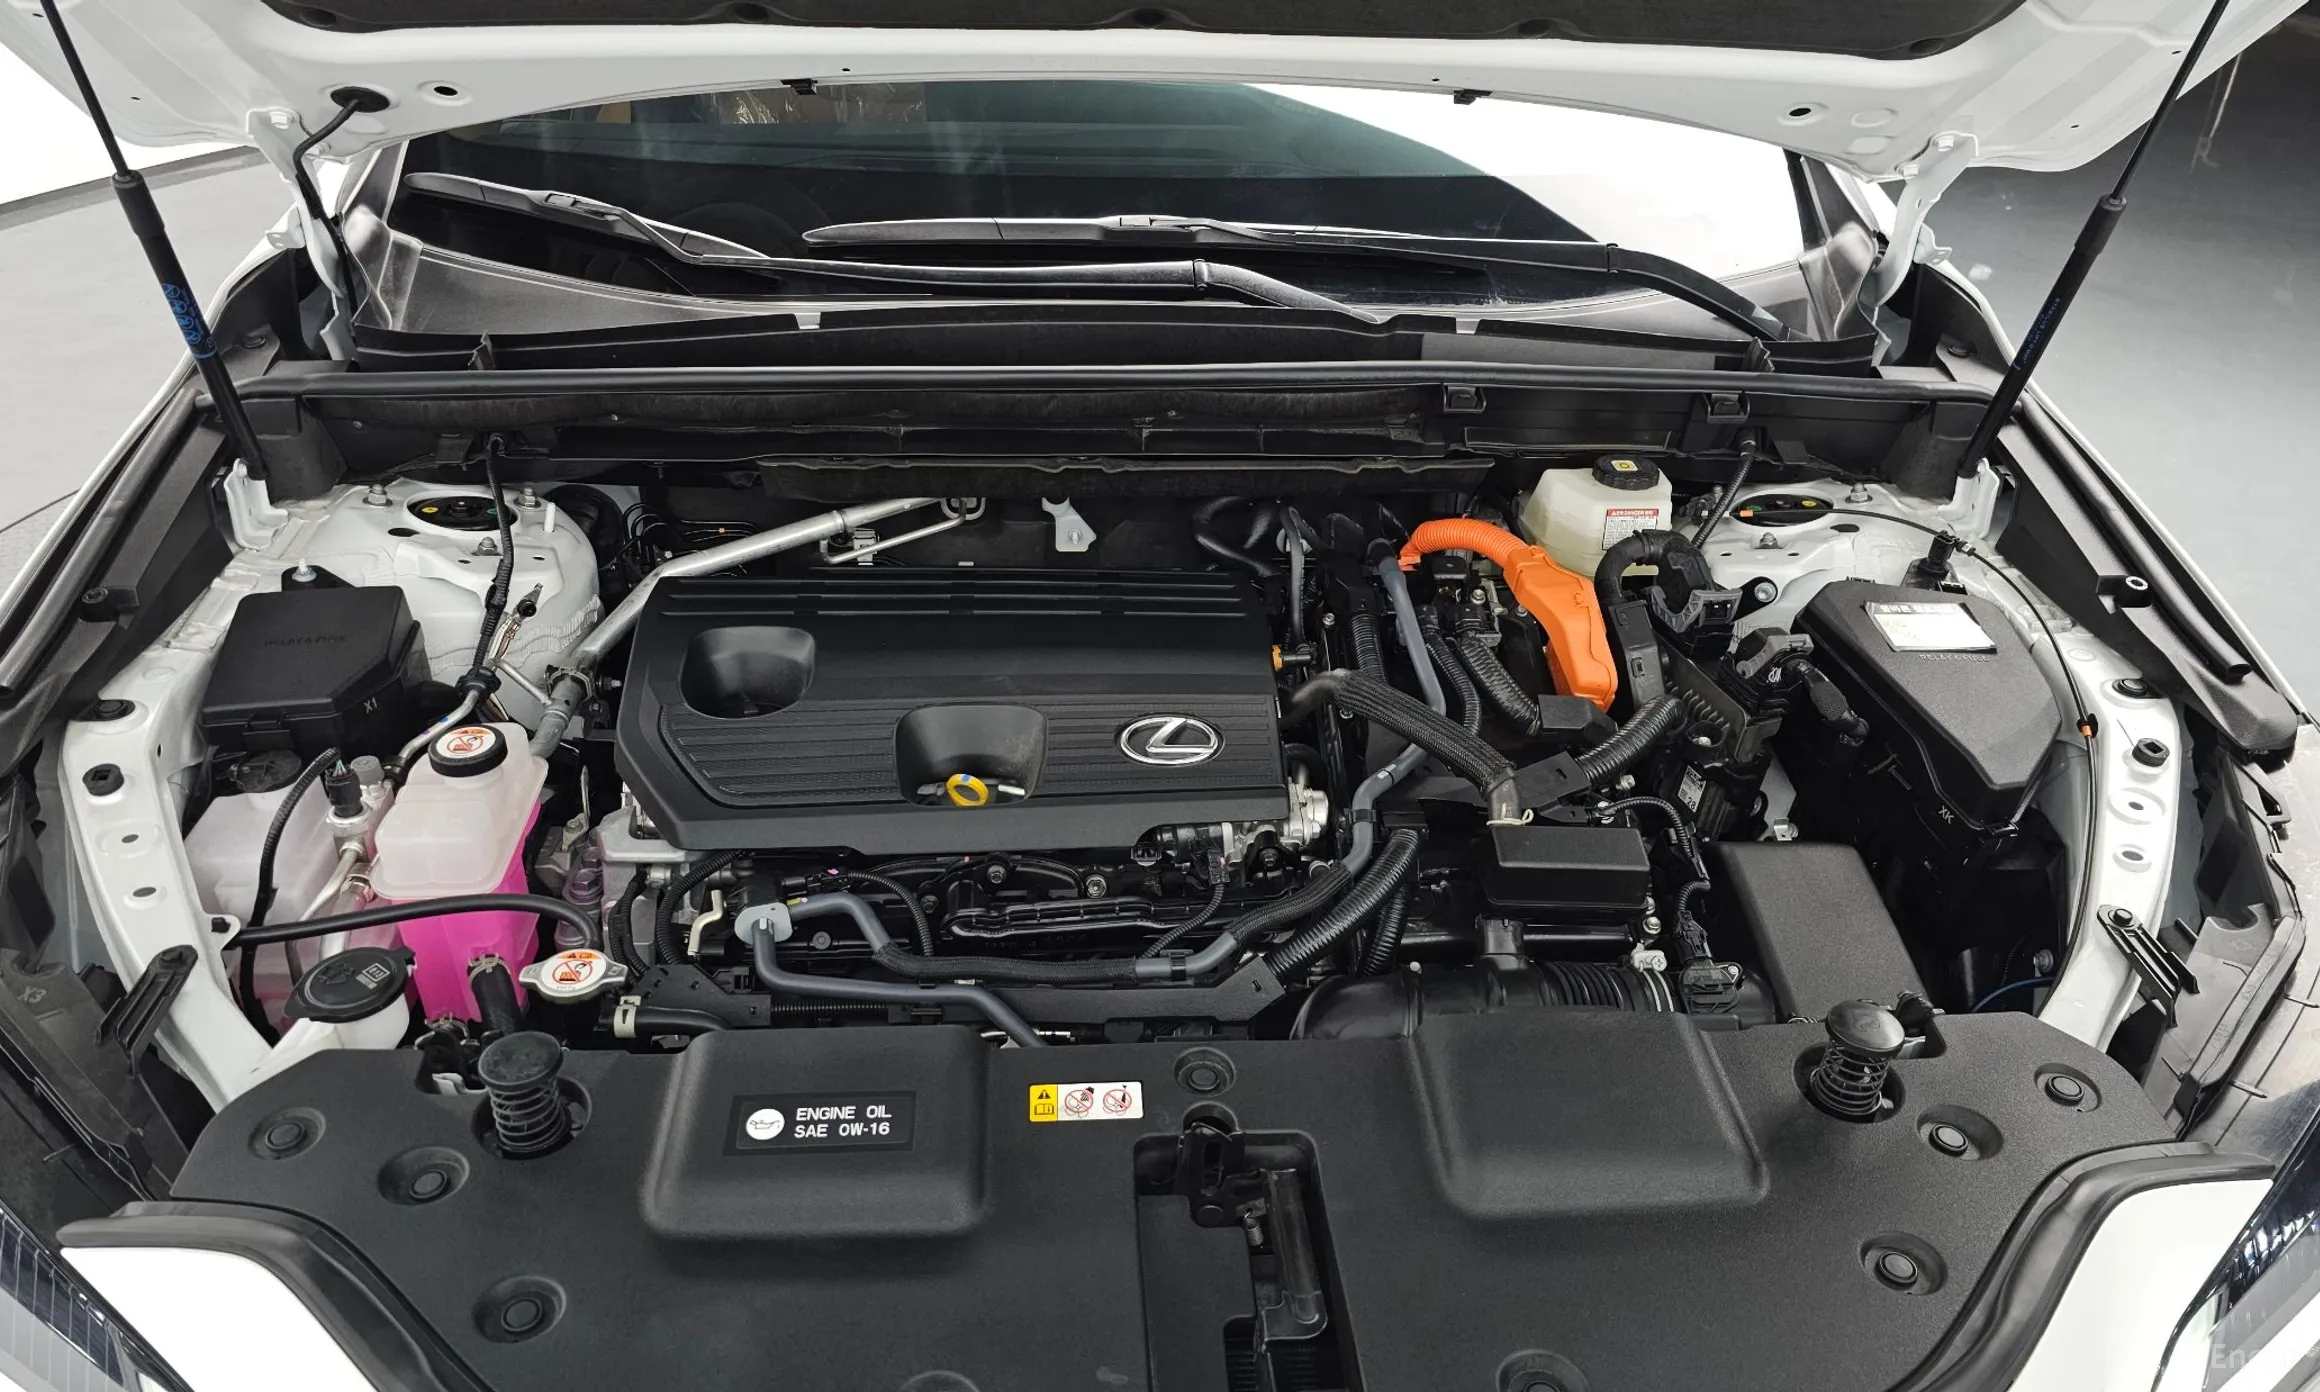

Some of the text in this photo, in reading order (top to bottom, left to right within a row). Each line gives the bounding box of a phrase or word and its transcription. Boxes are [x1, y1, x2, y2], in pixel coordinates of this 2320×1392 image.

[796, 1105, 892, 1121] ENGINE OIL
[794, 1122, 891, 1138] SAE 0W-16
